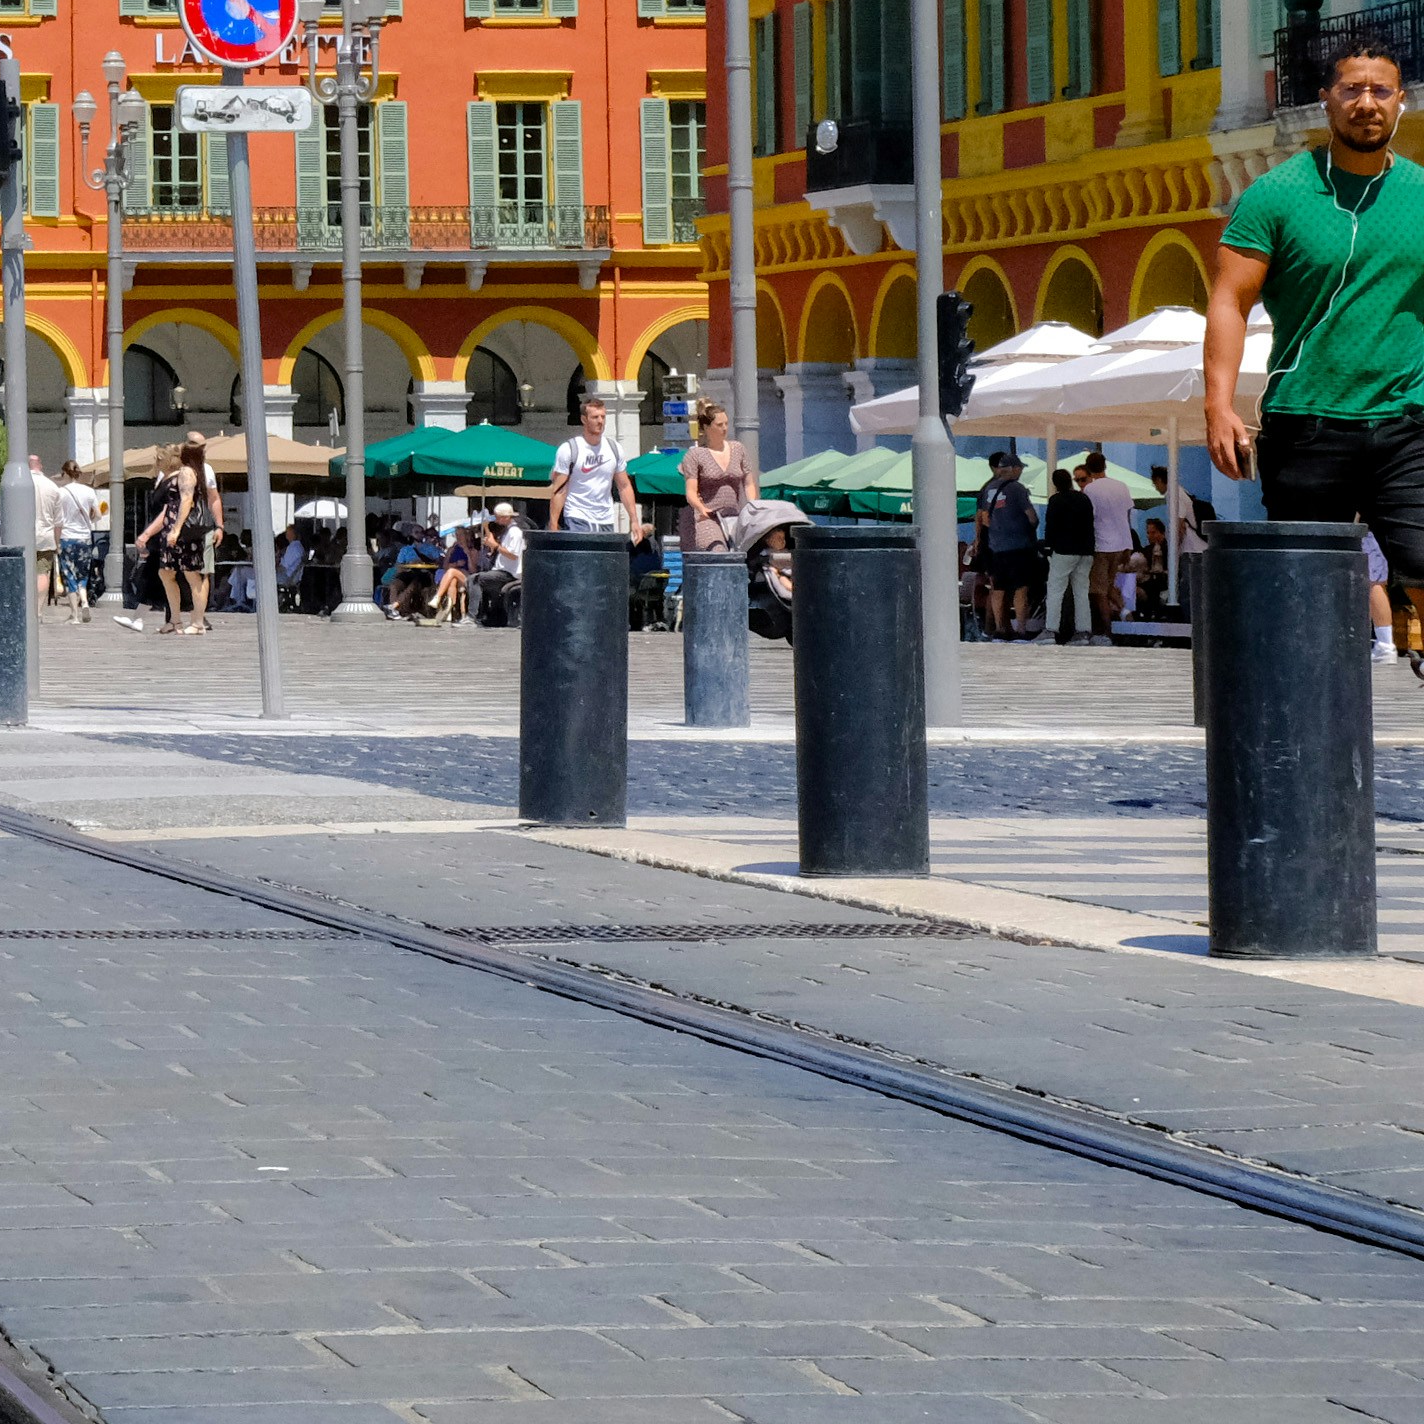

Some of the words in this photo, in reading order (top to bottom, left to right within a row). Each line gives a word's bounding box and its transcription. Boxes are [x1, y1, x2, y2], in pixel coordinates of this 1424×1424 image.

[155, 32, 372, 64] LAETTE
[585, 455, 604, 465] NIKE
[483, 466, 524, 478] ALBERT
